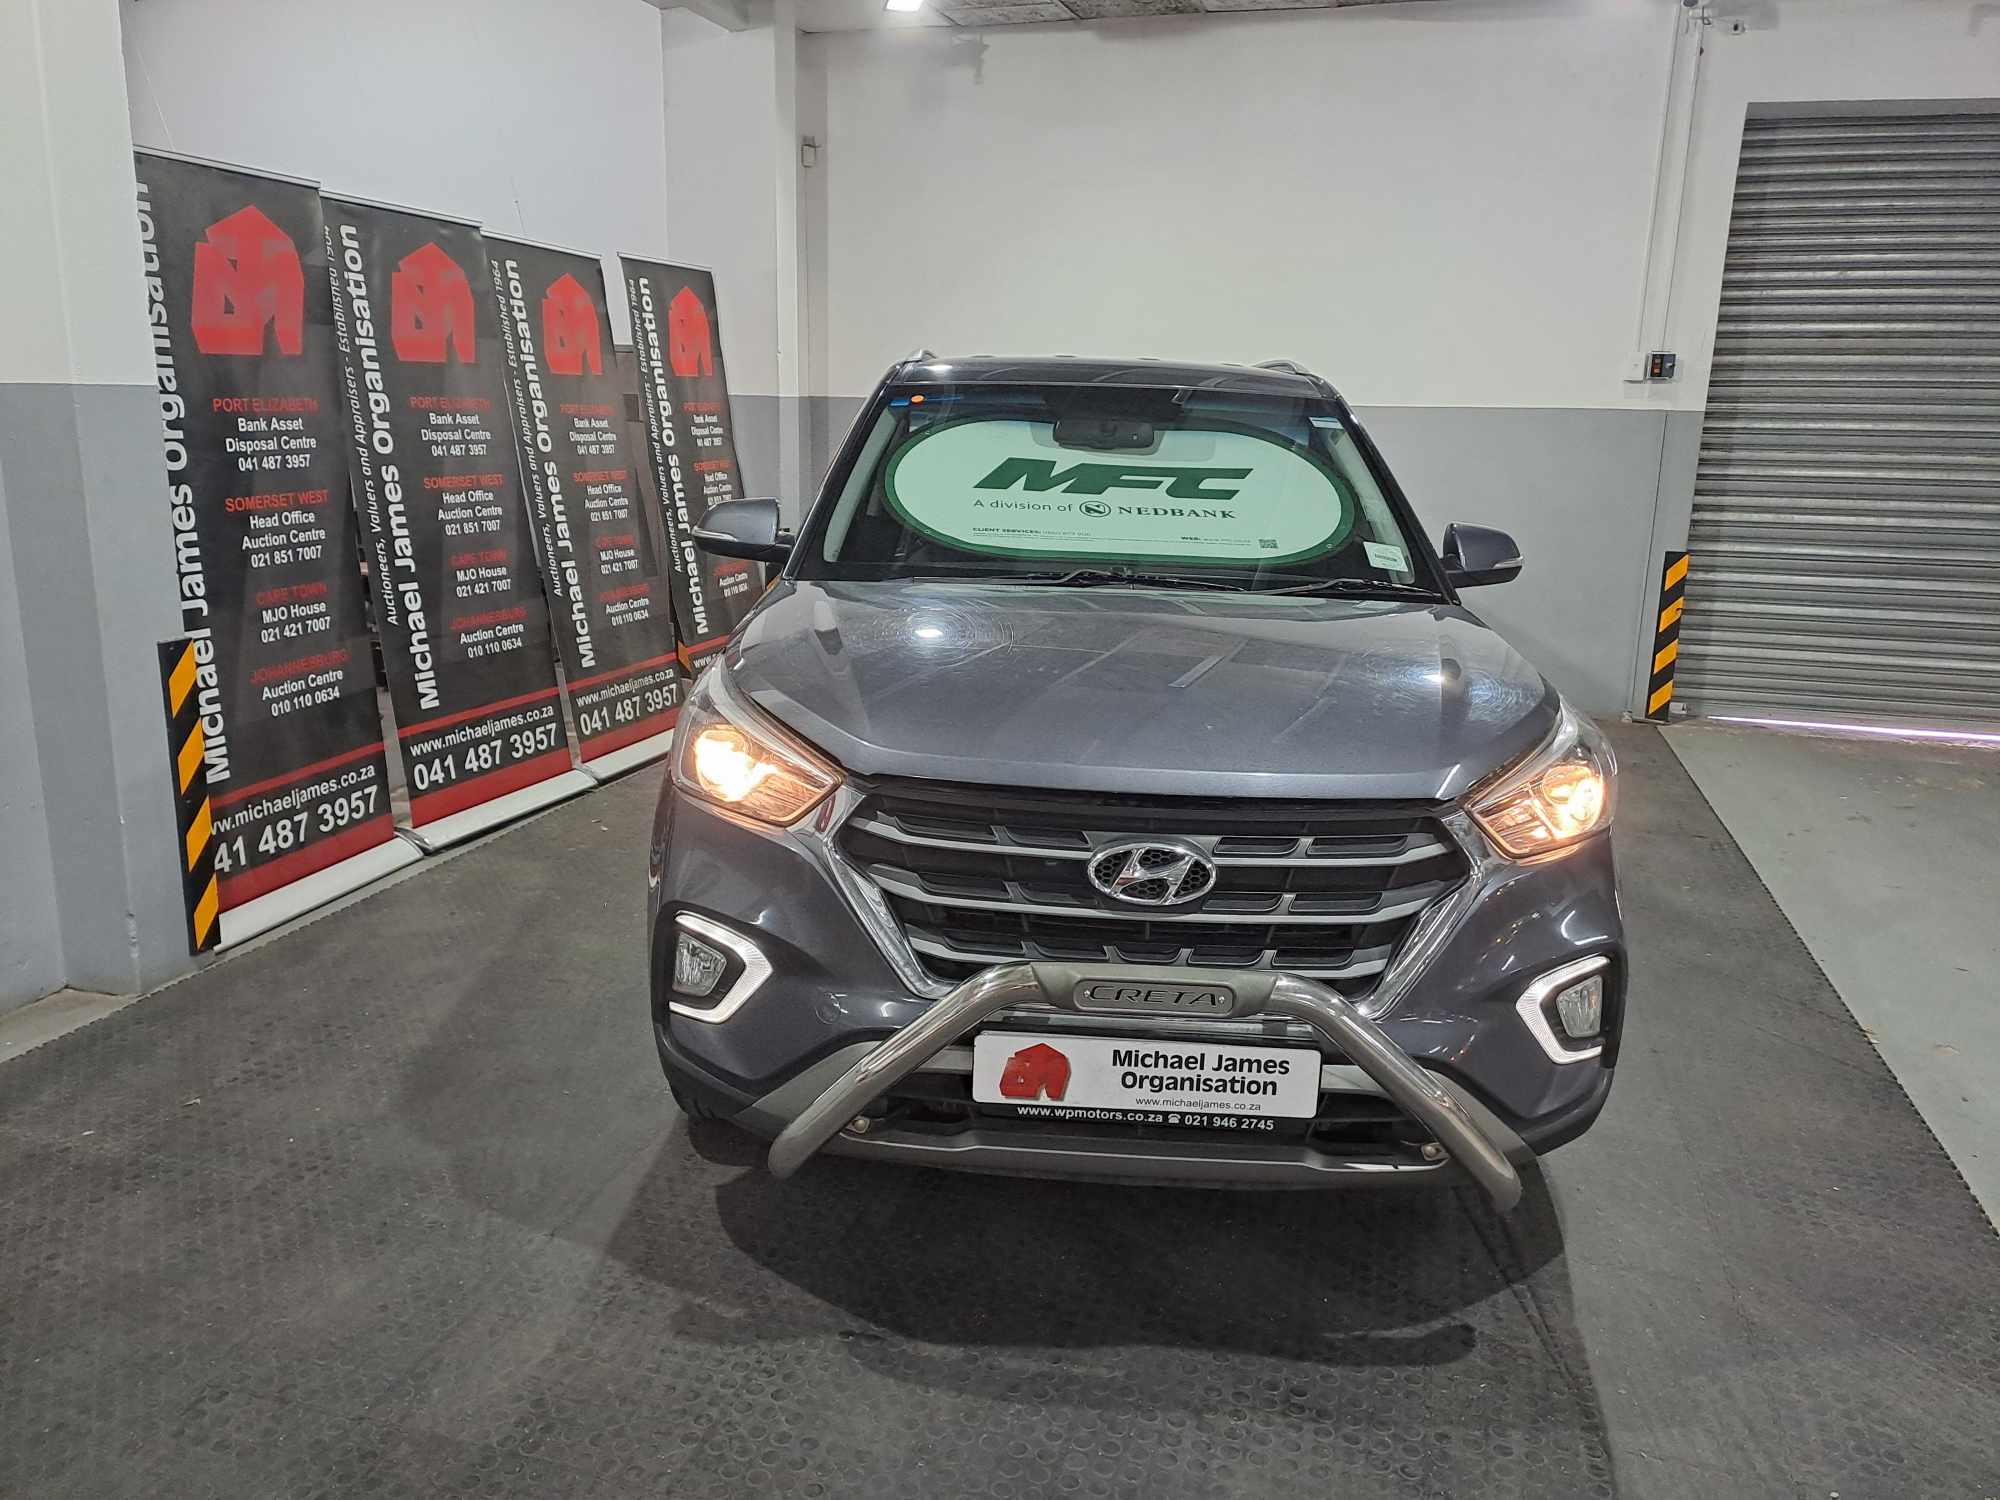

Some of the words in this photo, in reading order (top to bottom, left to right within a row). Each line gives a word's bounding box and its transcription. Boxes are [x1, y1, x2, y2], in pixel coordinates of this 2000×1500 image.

[491, 259, 504, 291] 1964
[340, 224, 394, 455] Organisation
[496, 294, 518, 368] Established
[505, 259, 552, 453] Organisation
[639, 277, 675, 447] Organisation
[212, 398, 248, 412] PORT
[253, 398, 320, 412] ELIZABETH
[345, 366, 368, 445] Appraisers
[429, 412, 454, 425] Bank
[456, 413, 480, 424] Asset
[514, 378, 533, 444] Appraisers
[237, 417, 268, 432] Bank
[270, 416, 304, 431] Asset
[421, 429, 461, 443] Disposal
[464, 429, 491, 440] Centre
[225, 437, 277, 454] Disposal
[280, 435, 317, 450] Centre
[431, 445, 448, 457] 041
[450, 444, 466, 455] 487
[469, 444, 487, 456] 3957
[524, 445, 537, 471] and
[652, 441, 663, 464] and
[238, 457, 258, 471] 041
[262, 455, 282, 469] 487
[285, 454, 311, 468] 3957
[356, 447, 372, 476] and
[972, 457, 1254, 501] MFC
[225, 493, 295, 512] SOMERSET
[297, 490, 329, 505] WEST
[364, 479, 382, 533] Valuers
[442, 491, 466, 504] Head
[468, 490, 494, 502] Office
[532, 473, 547, 519] Valuers
[544, 461, 573, 552] James
[668, 454, 690, 534] James
[249, 513, 279, 530] Head
[281, 511, 316, 525] Office
[381, 464, 416, 573] James
[438, 508, 474, 520] Auction
[475, 505, 503, 517] Centre
[974, 499, 984, 507] A
[990, 500, 1051, 511] division
[1057, 503, 1073, 512] of
[1118, 506, 1236, 519] NEDBANK
[242, 533, 287, 550] Auction
[289, 528, 326, 544] Centre
[445, 523, 461, 536] 021
[463, 521, 479, 534] 851
[481, 520, 501, 532] 7007
[170, 483, 208, 617] James
[251, 554, 271, 568] 021
[274, 550, 294, 565] 851
[297, 546, 322, 561] 7007
[541, 522, 563, 597] Auctioneers,
[376, 538, 399, 626] Auctioneers,
[456, 568, 477, 582] MJO
[478, 566, 507, 579] House
[680, 540, 709, 634] Michael
[456, 586, 472, 598] 021
[474, 582, 489, 595] 421
[492, 579, 511, 592] 7007
[262, 607, 288, 624] MJO
[290, 602, 326, 617] House
[560, 560, 596, 669] Michael
[261, 628, 280, 643] 021
[283, 622, 306, 638] 421
[306, 616, 331, 633] 7007
[460, 629, 494, 644] Auction
[495, 623, 524, 636] Centre
[398, 582, 440, 711] Michael
[467, 645, 483, 658] 010
[485, 641, 500, 654] 110
[502, 637, 523, 651] 0634
[262, 680, 305, 700] Auction
[308, 669, 343, 687] Centre
[575, 668, 675, 708] www.michaeljames.co.za
[185, 628, 231, 784] Michael
[271, 701, 291, 717] 010
[293, 694, 312, 710] 110
[315, 686, 340, 704] 0634
[579, 705, 611, 736] 041
[615, 695, 641, 723] 487
[646, 683, 679, 713] 3957
[410, 704, 555, 757] www.michaeljames.co.za
[413, 754, 456, 791] 041
[464, 739, 502, 778] 487
[509, 722, 558, 759] 3957
[214, 835, 247, 874] 41
[258, 811, 309, 855] 487
[317, 784, 378, 833] 3957
[1089, 985, 1217, 1006] CRETA
[1112, 1048, 1205, 1071] Michael
[1212, 1054, 1290, 1075] James
[1121, 1071, 1277, 1096] Organisation
[1018, 1106, 1163, 1124] www.wpmotors.co.za
[1184, 1114, 1208, 1127] 021
[1212, 1116, 1238, 1129] 946
[1241, 1118, 1274, 1131] 2745
[1136, 1097, 1261, 1112] www.michaeljames.co.za
